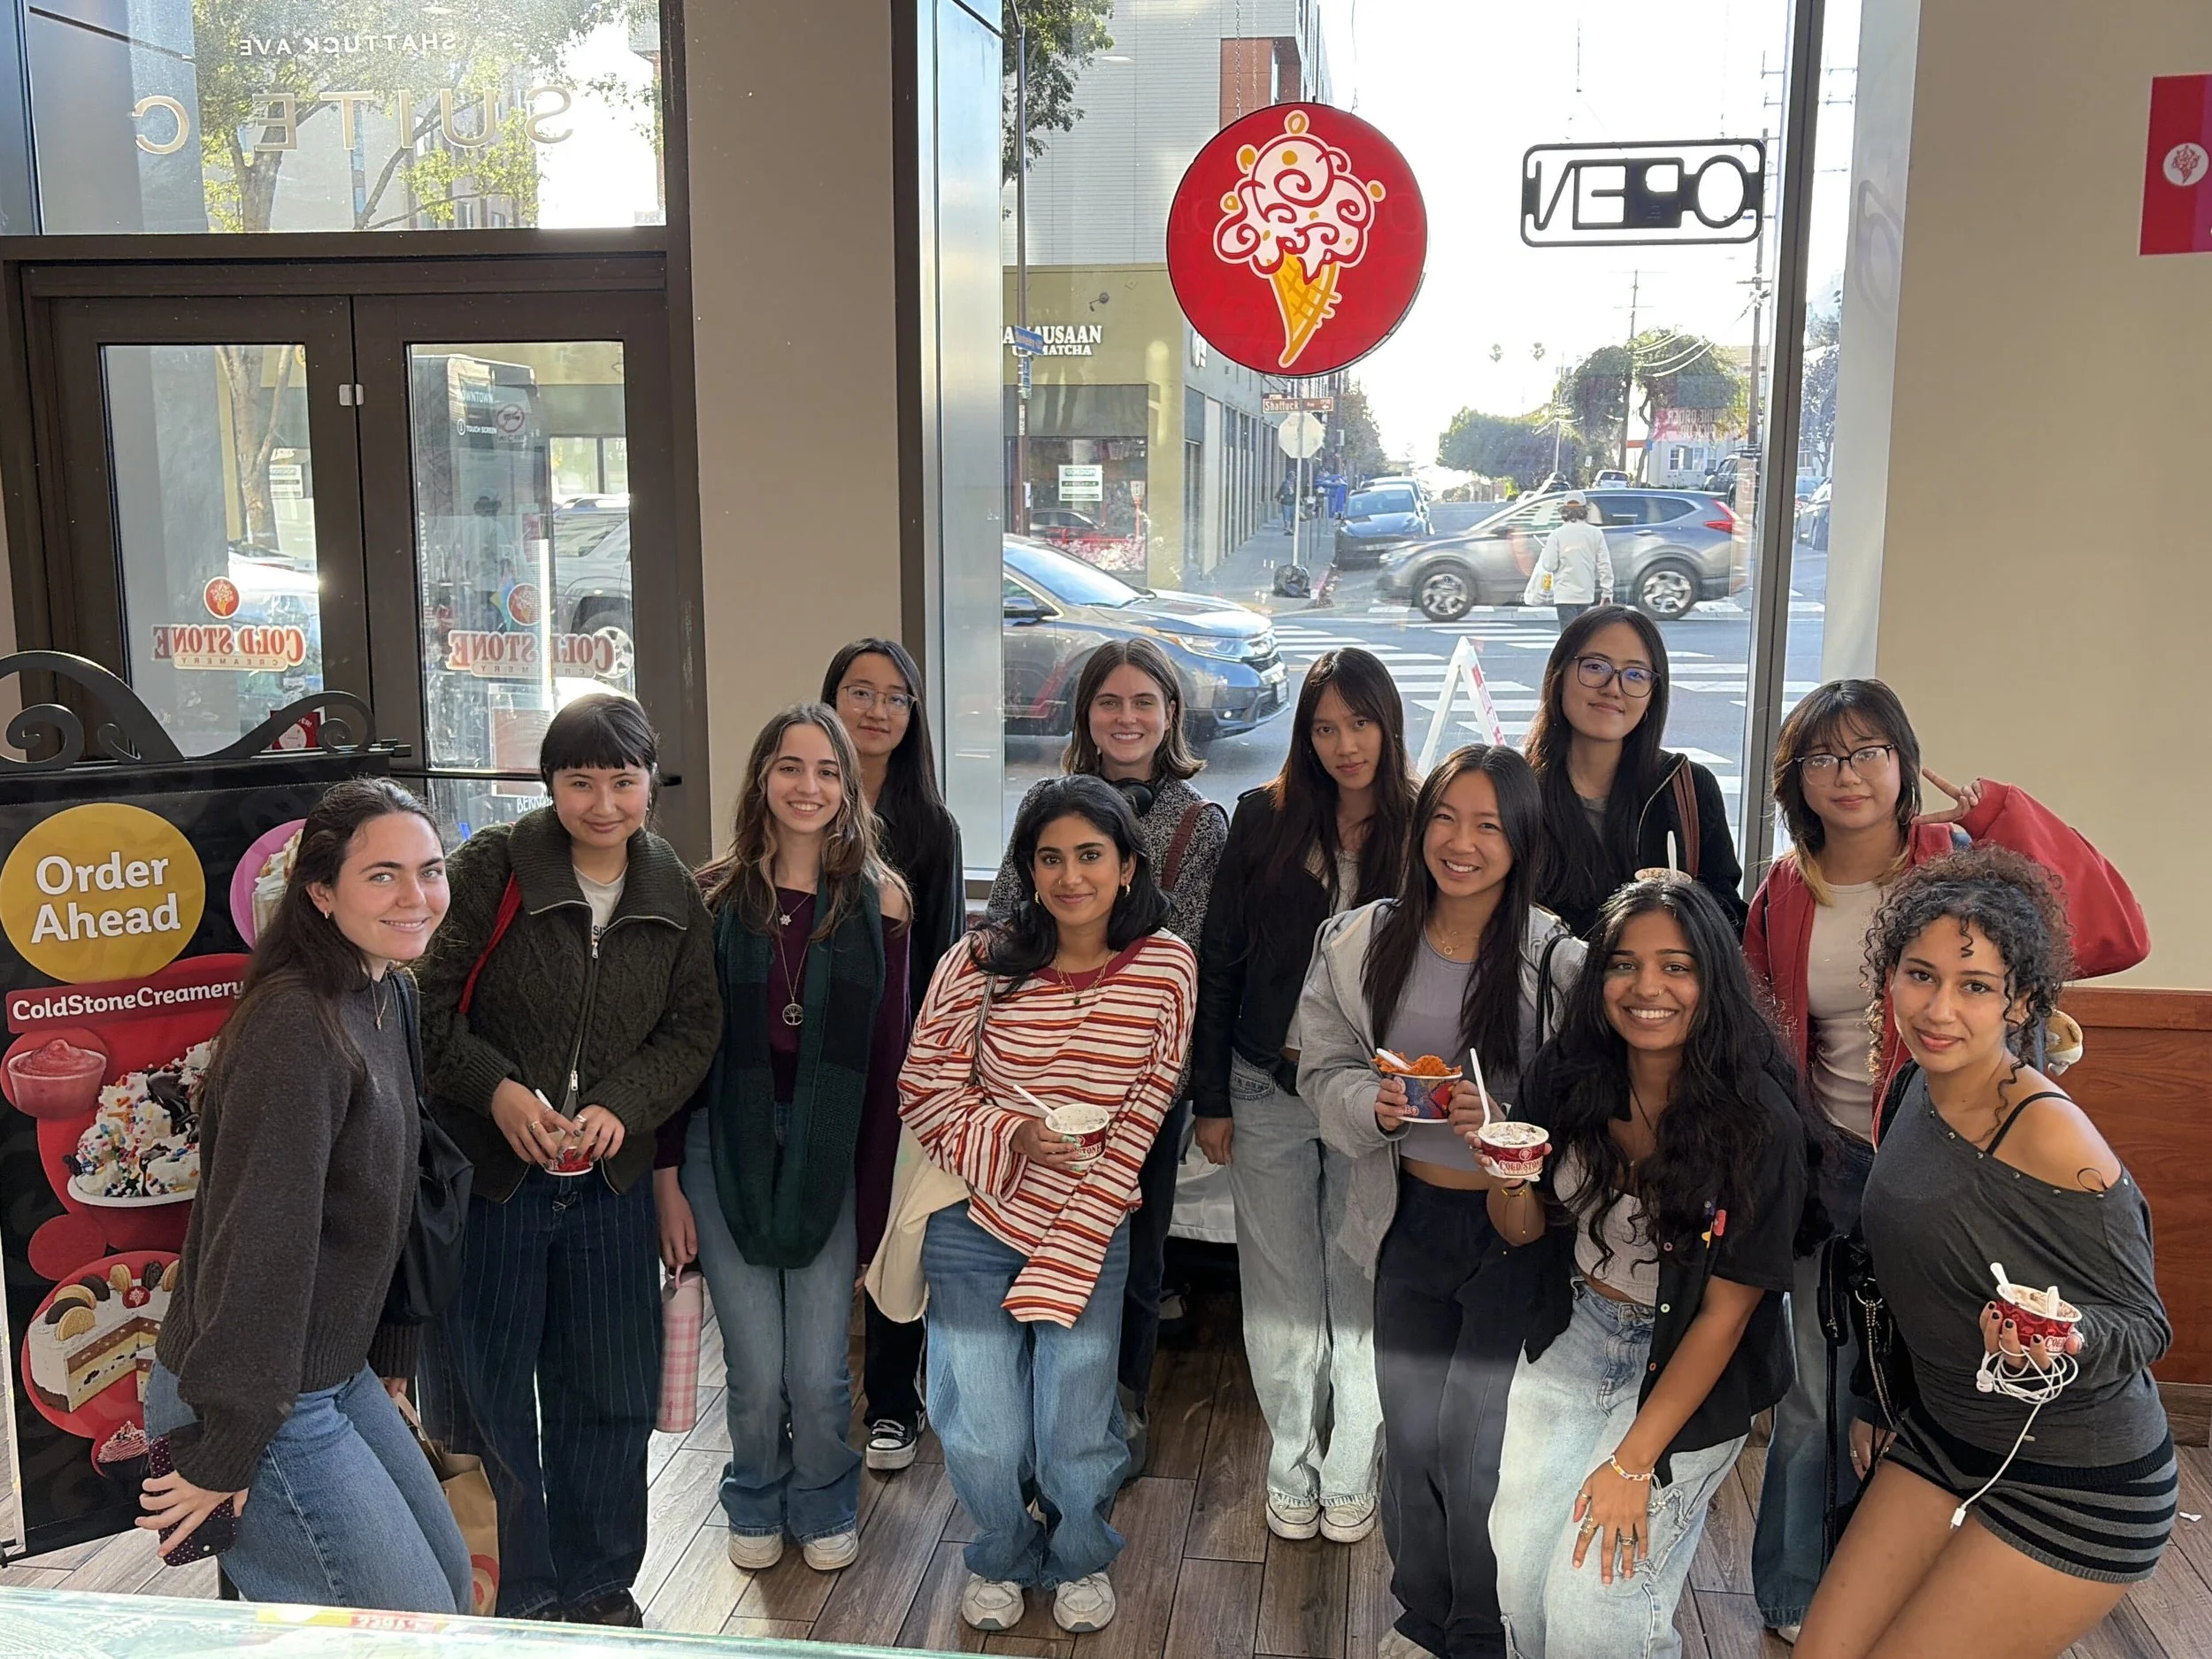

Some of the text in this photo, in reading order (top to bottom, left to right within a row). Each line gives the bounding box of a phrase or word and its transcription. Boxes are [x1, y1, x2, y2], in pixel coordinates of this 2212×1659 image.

[1002, 325, 1102, 344] AUSAAN
[461, 389, 494, 404] OWNTOWN
[1264, 401, 1299, 411] Shattuck
[35, 851, 169, 895] Order
[31, 892, 181, 944] Ahead
[12, 979, 245, 1021] ColdStoneCreamery
[1500, 1161, 1522, 1171] COLD
